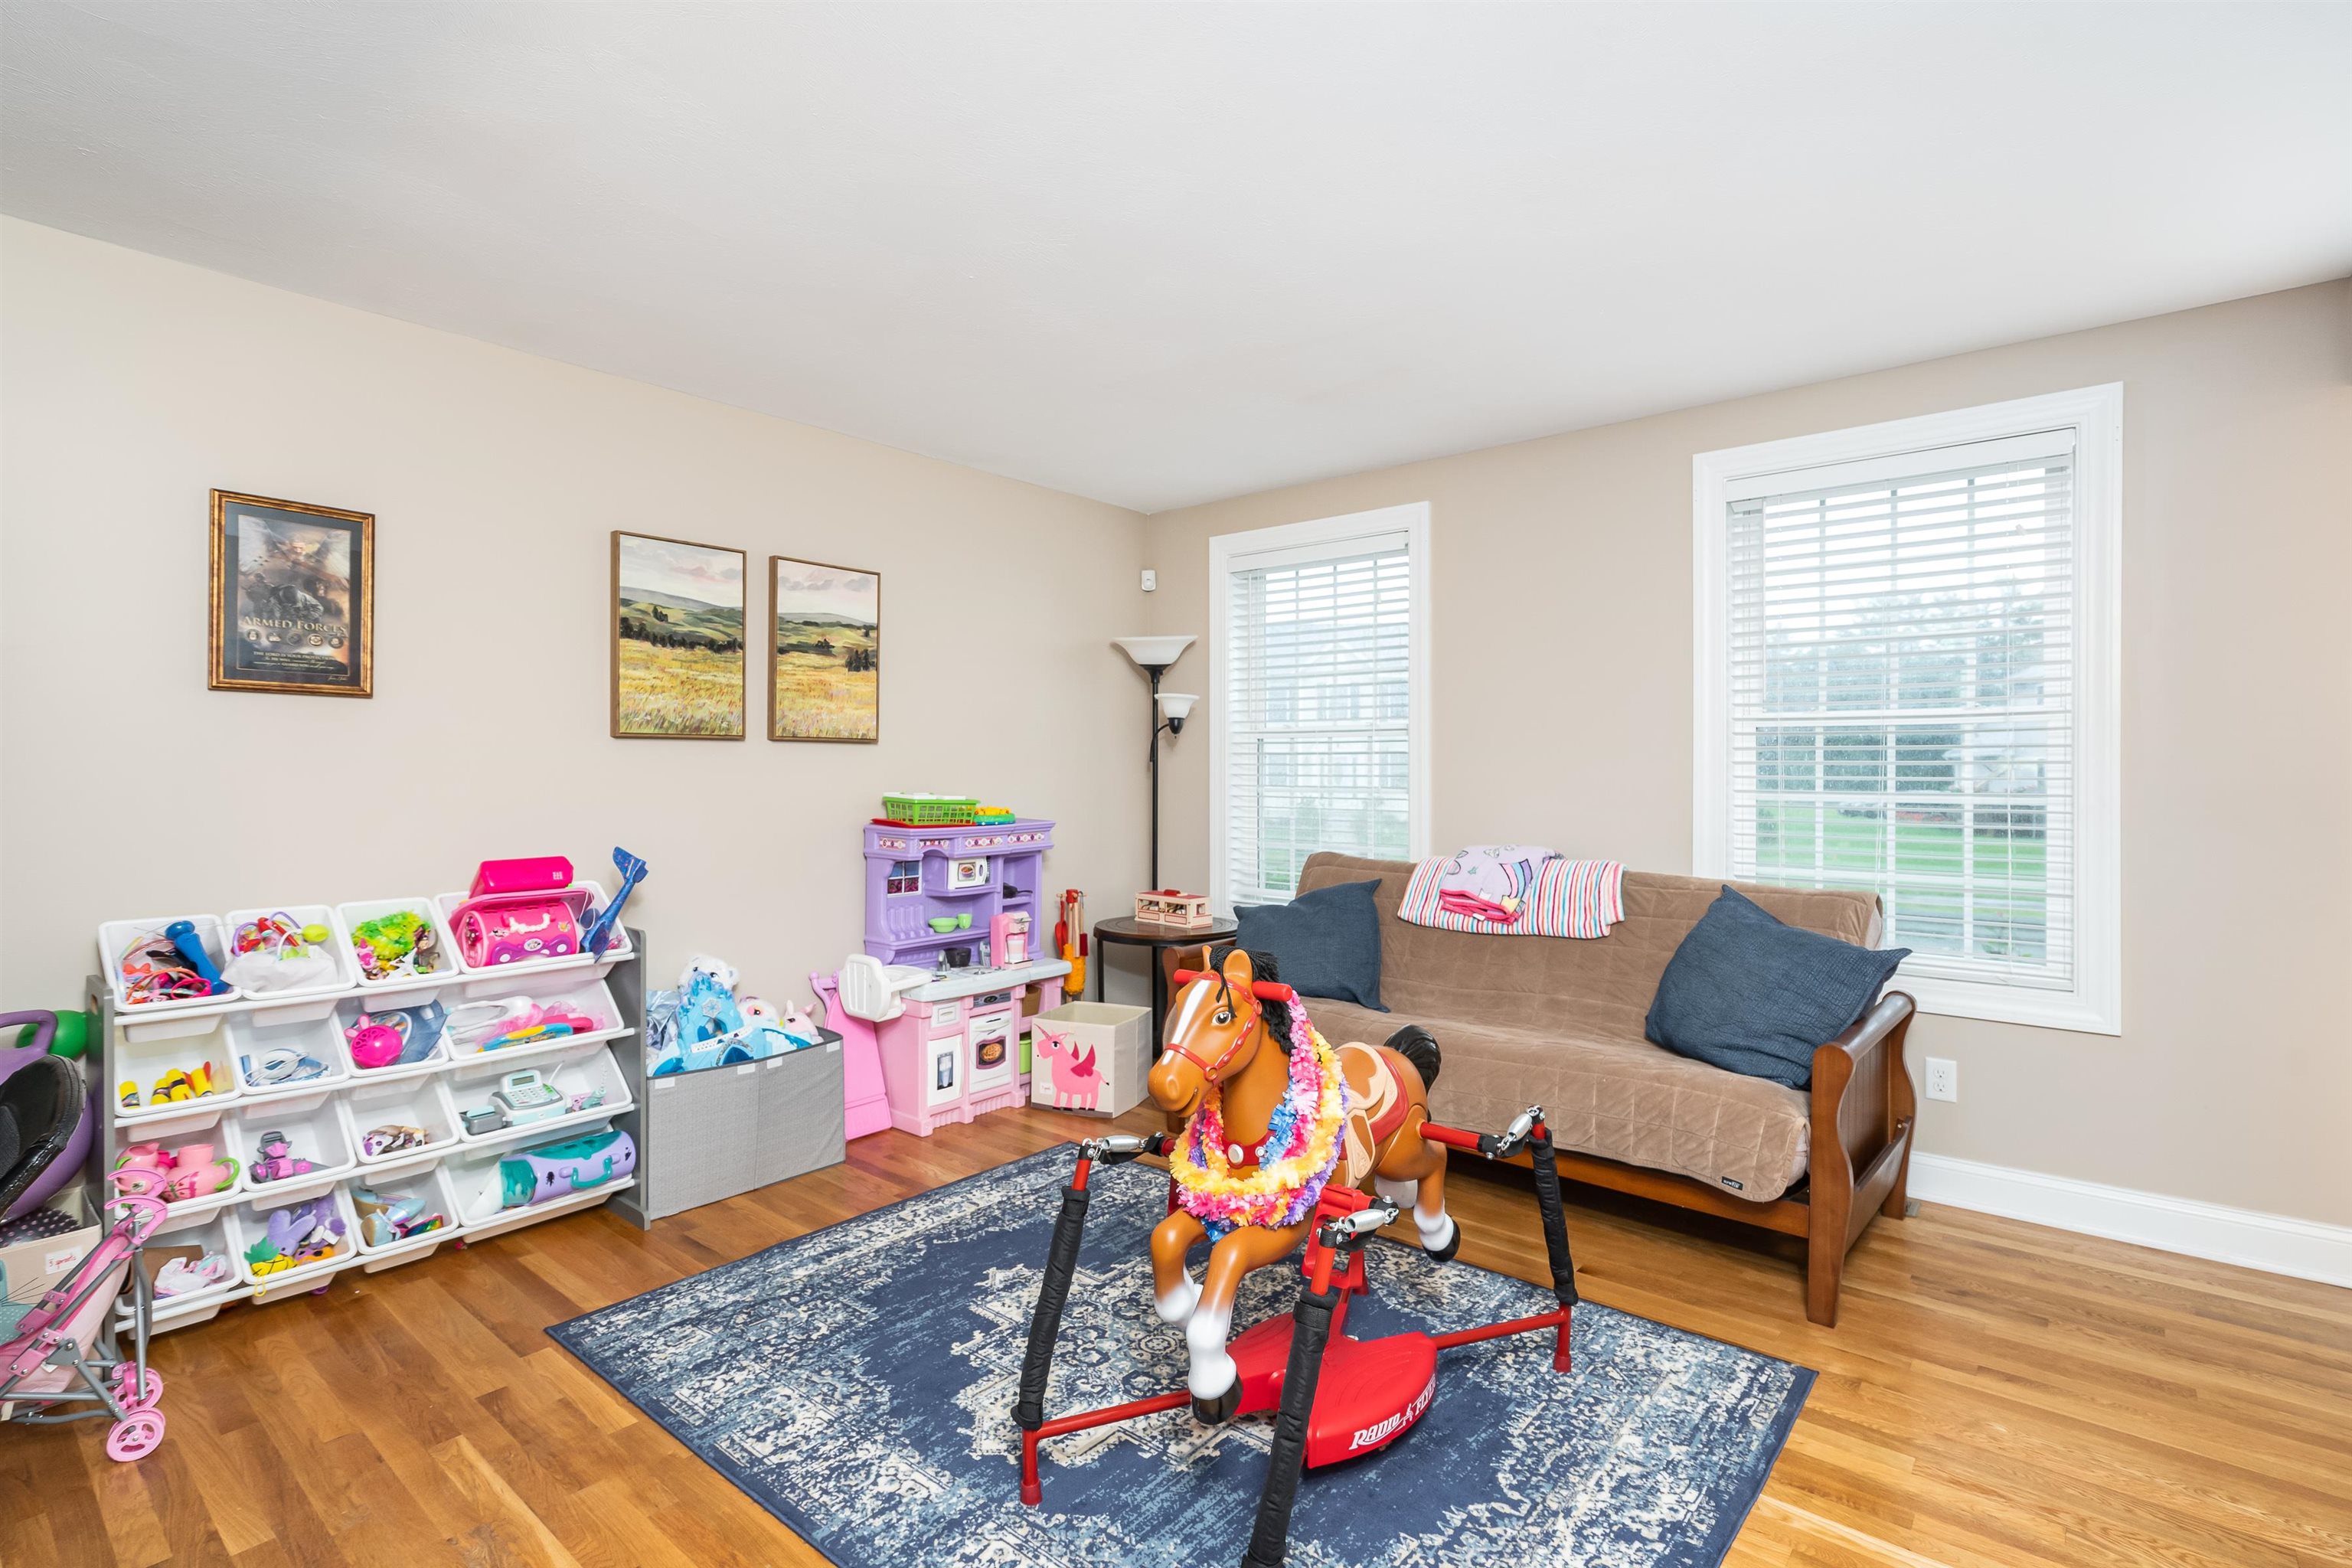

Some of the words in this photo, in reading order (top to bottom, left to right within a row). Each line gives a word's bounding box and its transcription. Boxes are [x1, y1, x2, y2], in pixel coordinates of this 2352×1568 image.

[243, 616, 292, 629] ARMED
[296, 619, 347, 632] FORCES
[1348, 1413, 1402, 1450] RADIO
